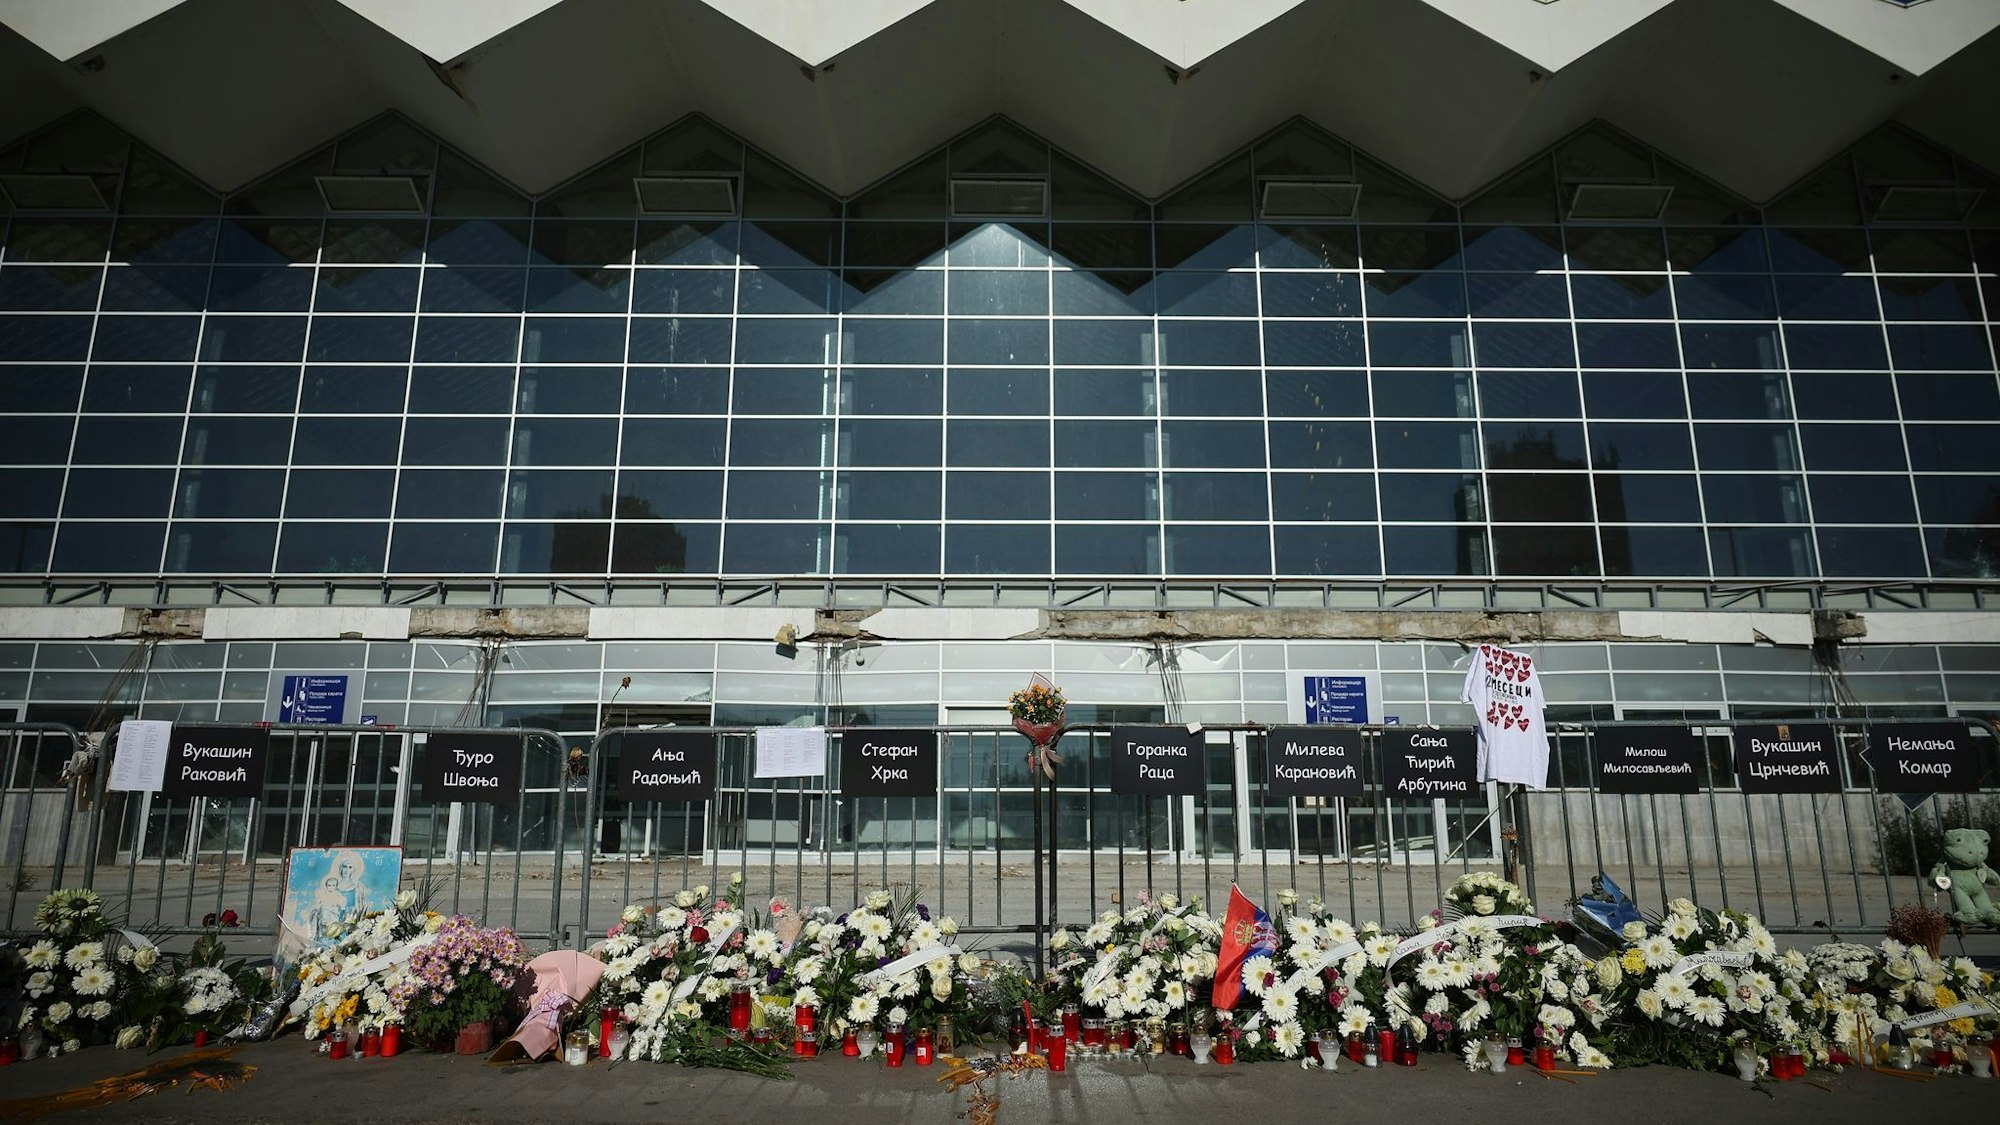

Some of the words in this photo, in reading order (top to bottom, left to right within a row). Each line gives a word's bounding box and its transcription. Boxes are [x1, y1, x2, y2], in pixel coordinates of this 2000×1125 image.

[1284, 741, 1345, 757] Милева
[1410, 733, 1448, 748] Сања
[1751, 739, 1822, 757] Вукашин
[1887, 736, 1956, 751] Немања
[182, 742, 253, 762] Вукашин
[452, 749, 494, 768] Ђуро
[651, 747, 685, 762] Ања
[861, 742, 918, 761] Стефан
[1126, 741, 1188, 760] Горанка
[1624, 746, 1667, 757] Милош
[1139, 763, 1175, 781] Раца
[1404, 754, 1456, 773] Ћирић
[1603, 762, 1692, 776] Милосављевић
[1749, 760, 1830, 781] Црнчевић
[1898, 759, 1952, 778] Комар
[181, 765, 247, 782] Раковић
[443, 771, 499, 788] Швоња
[632, 769, 702, 787] Радоњић
[871, 765, 909, 784] Хрка
[1274, 763, 1357, 783] Карановић
[1397, 776, 1468, 795] Арбутина
